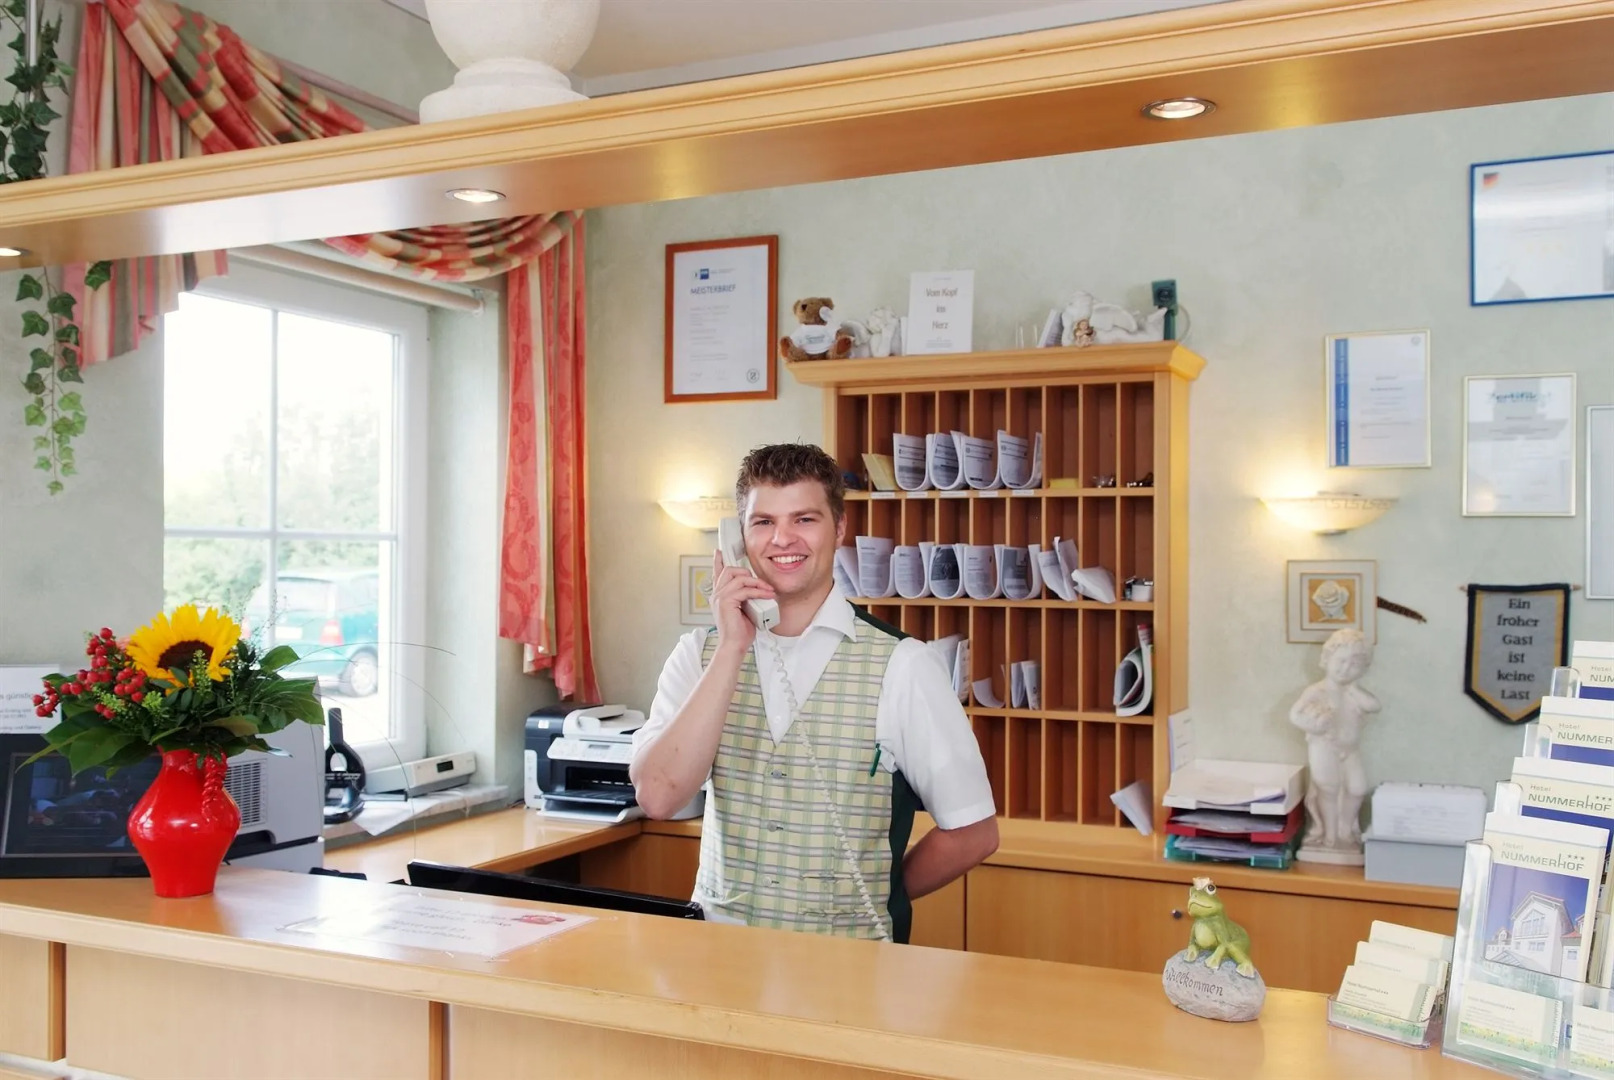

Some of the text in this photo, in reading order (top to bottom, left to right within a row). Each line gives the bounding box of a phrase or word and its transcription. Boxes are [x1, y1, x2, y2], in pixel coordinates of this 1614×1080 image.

[925, 287, 959, 299] Vom Kopf
[931, 320, 949, 330] Herz
[1508, 598, 1531, 610] Ein
[1497, 613, 1540, 628] froher
[1502, 633, 1533, 646] Gast
[1508, 651, 1526, 664] ist
[1497, 669, 1536, 682] keine
[1500, 689, 1531, 700] Last
[1558, 722, 1581, 730] Hotel
[1530, 783, 1552, 792] Hotel
[1528, 793, 1612, 812] NUMMERHOF
[1500, 851, 1585, 872] NUMMERHOF
